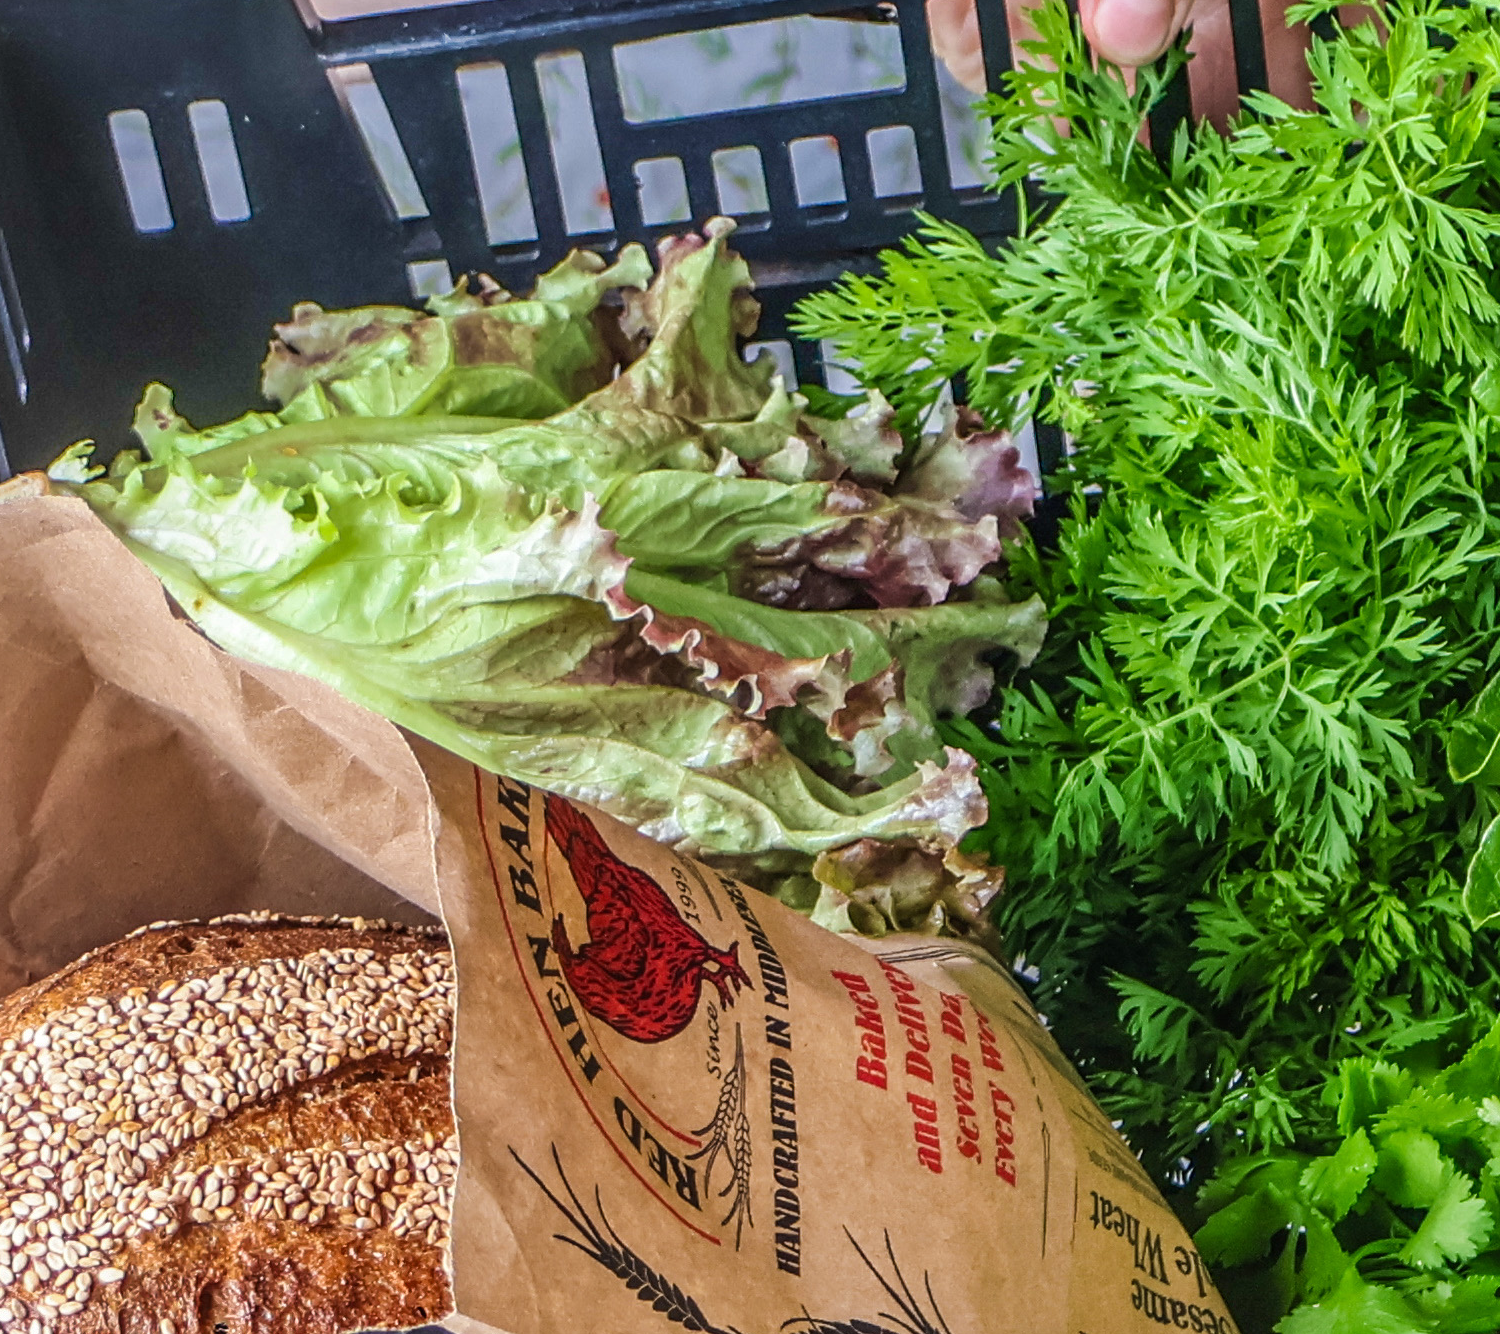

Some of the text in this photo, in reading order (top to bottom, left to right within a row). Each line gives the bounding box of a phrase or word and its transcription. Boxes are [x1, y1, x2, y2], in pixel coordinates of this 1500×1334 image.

[498, 775, 703, 1212] RED HEN BAK
[670, 866, 722, 1080] Since 1999
[765, 1014, 793, 1050] IN
[830, 969, 888, 1091] Baked
[875, 956, 943, 1175] and Deliver
[940, 990, 982, 1165] Seven Da
[988, 1079, 1018, 1188] Every
[769, 1057, 801, 1277] HANDCRAFTED
[1089, 1189, 1171, 1287] Wheat
